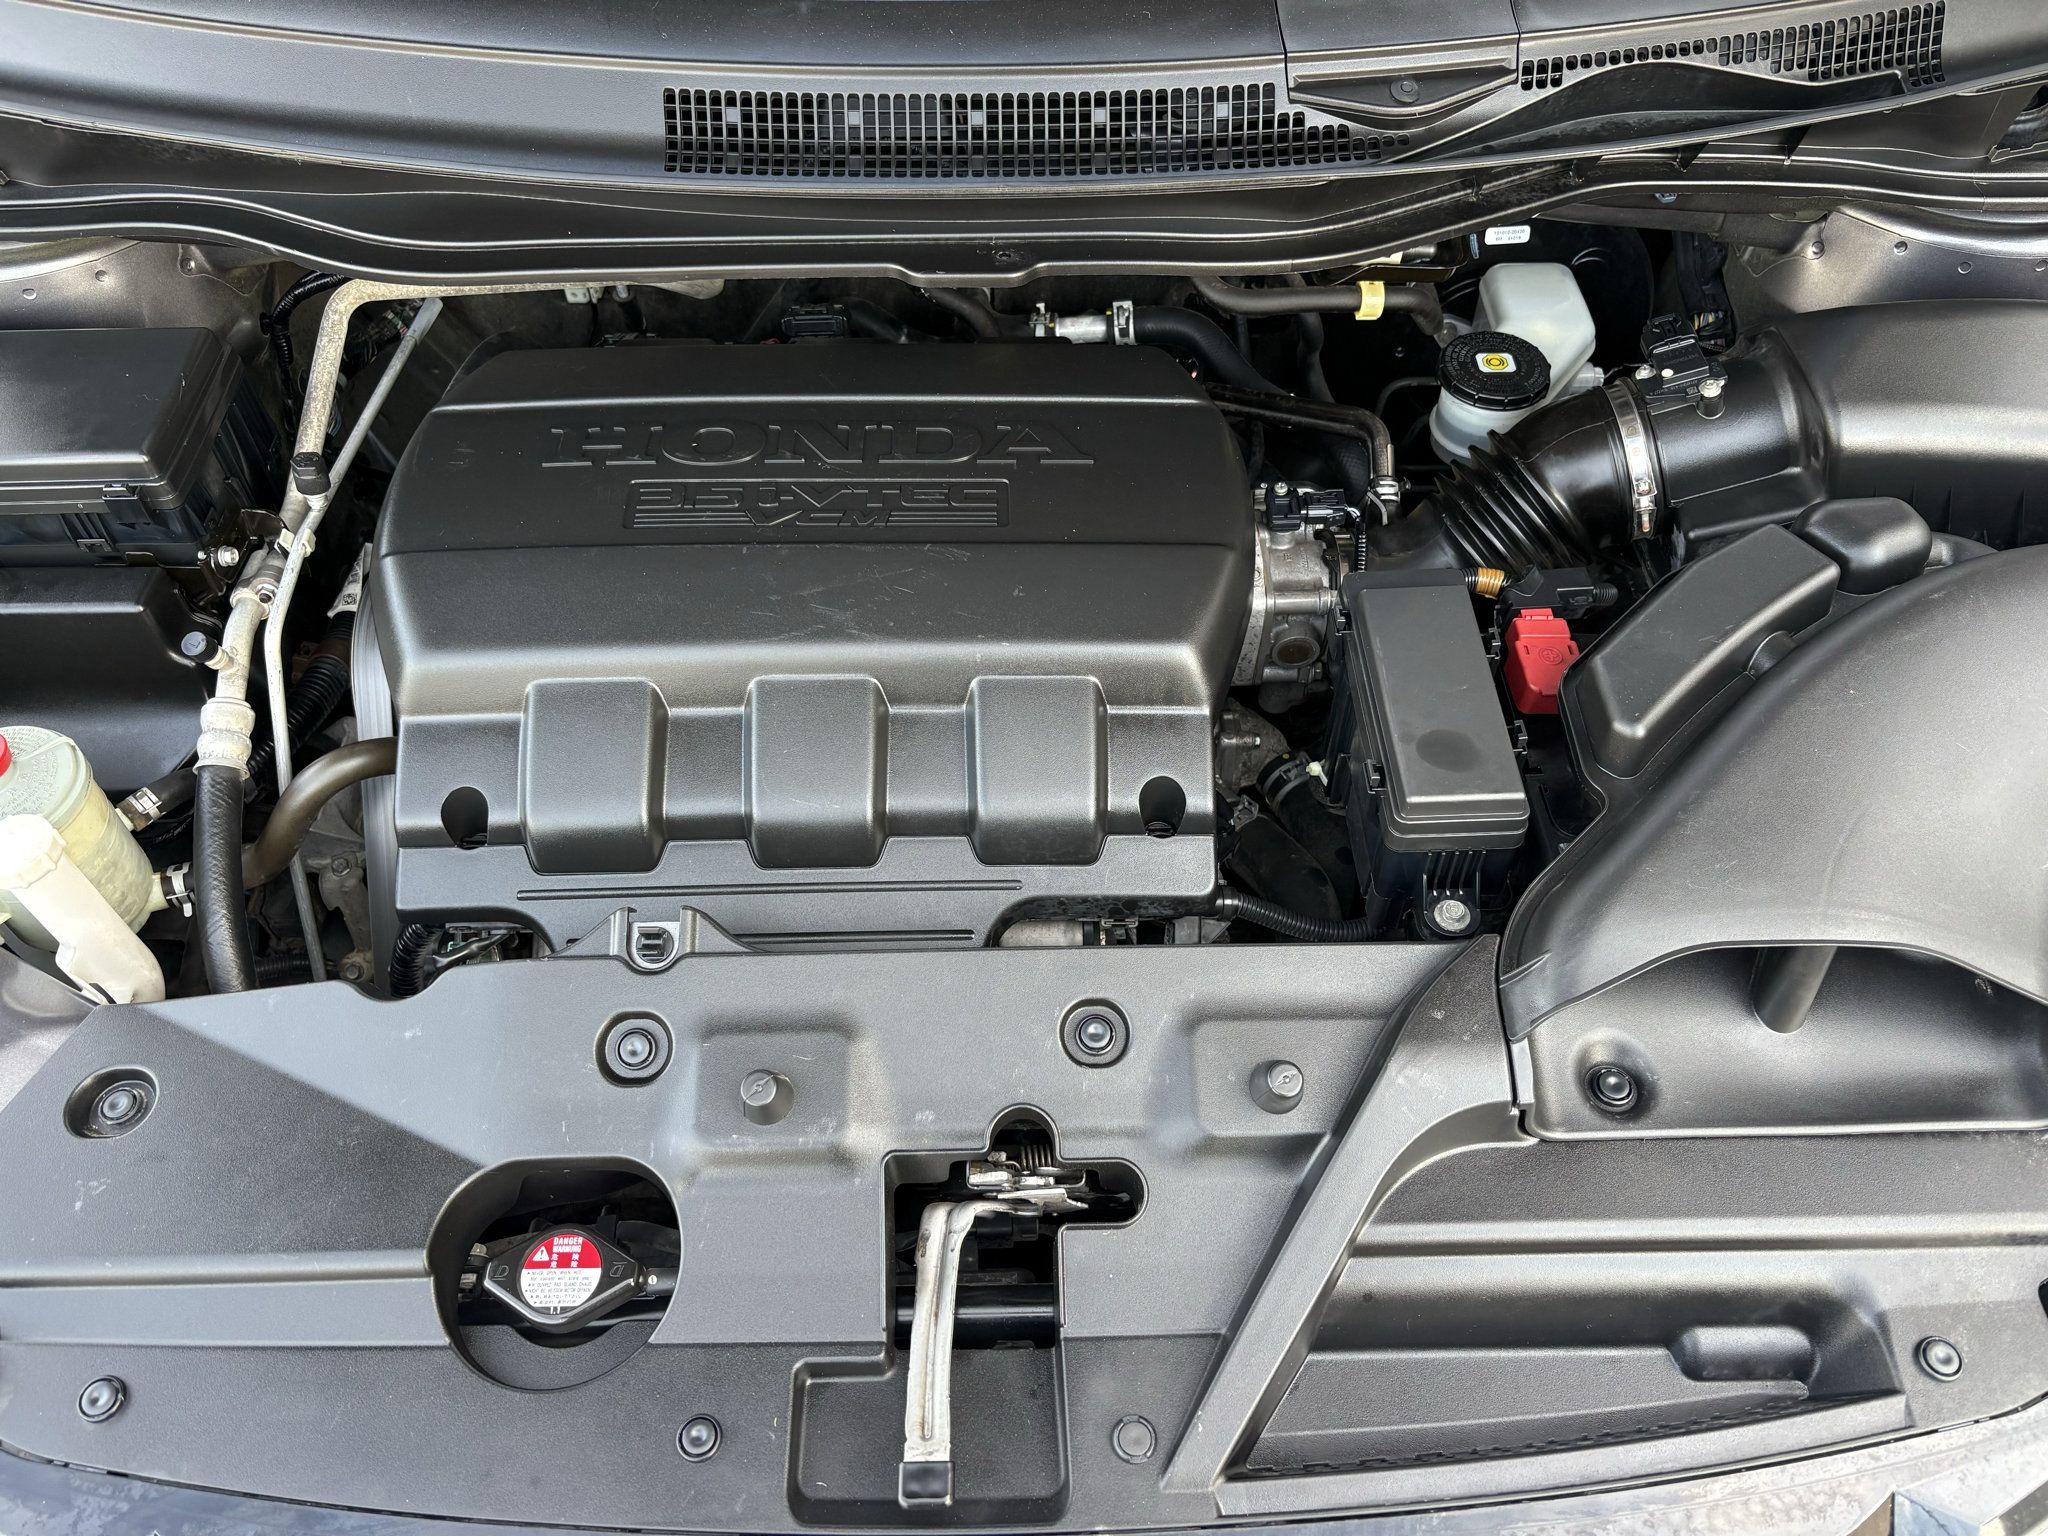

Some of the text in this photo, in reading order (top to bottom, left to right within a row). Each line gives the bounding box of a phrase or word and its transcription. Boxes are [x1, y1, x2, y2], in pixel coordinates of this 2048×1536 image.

[541, 423, 1095, 468] HONDA
[746, 509, 891, 527] VCM
[553, 1236, 583, 1245] DANGER
